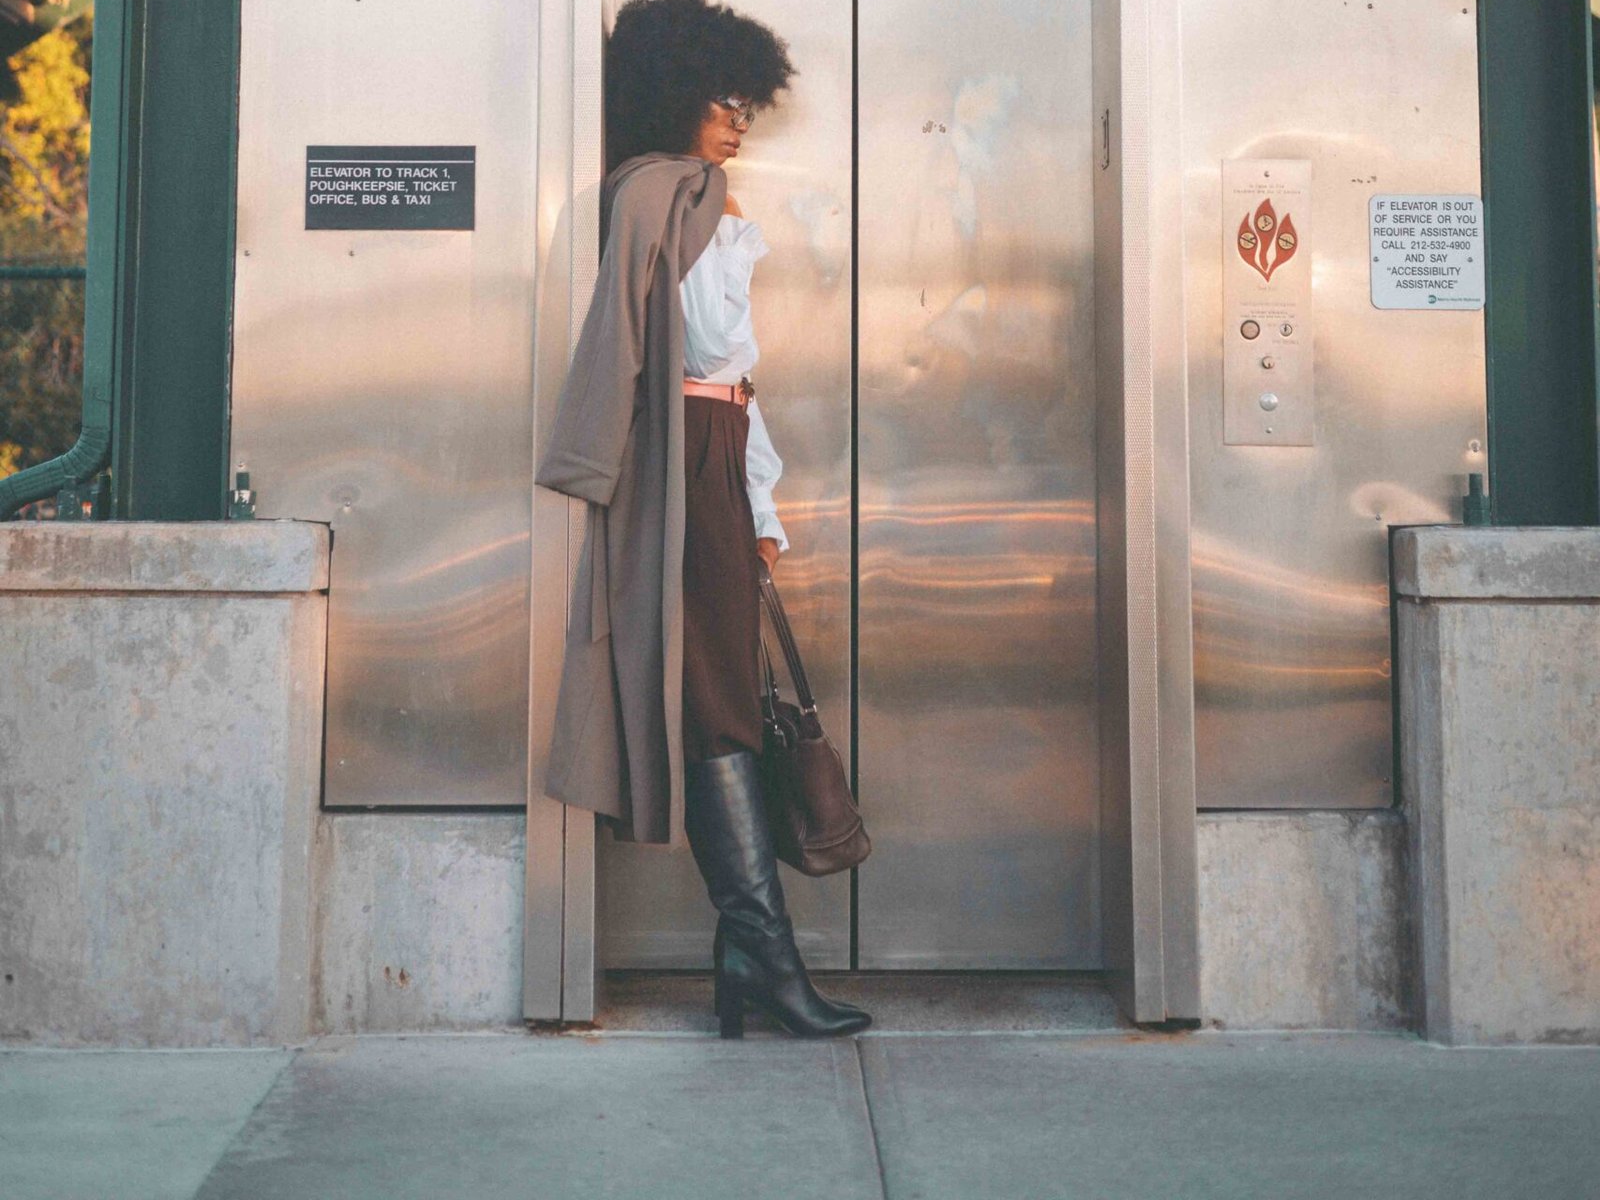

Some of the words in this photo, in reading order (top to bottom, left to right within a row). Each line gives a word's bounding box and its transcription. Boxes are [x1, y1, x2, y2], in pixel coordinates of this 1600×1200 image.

[310, 167, 371, 178] ELEVATOR
[375, 168, 392, 178] TO
[396, 168, 438, 178] TRACK
[442, 169, 450, 179] 1,
[309, 181, 408, 192] POUGHKEEPSIE,
[413, 182, 457, 191] TICKET
[309, 194, 357, 206] OFFICE,
[362, 195, 387, 205] BUS
[391, 195, 400, 205] &
[404, 195, 431, 205] TAXI
[1376, 202, 1385, 210] IF
[1390, 202, 1438, 211] ELEVATOR
[1443, 202, 1451, 211] IS
[1454, 202, 1473, 211] OUT
[1374, 215, 1387, 223] OF
[1393, 215, 1432, 223] SERVICE
[1437, 215, 1451, 223] OR
[1457, 215, 1476, 224] YOU
[1373, 227, 1415, 236] REQUIRE
[1420, 228, 1478, 237] ASSISTANCE
[1381, 241, 1405, 249] CALL
[1411, 241, 1470, 250] 212-532-4900
[1405, 254, 1425, 262] AND
[1430, 254, 1447, 262] SAY
